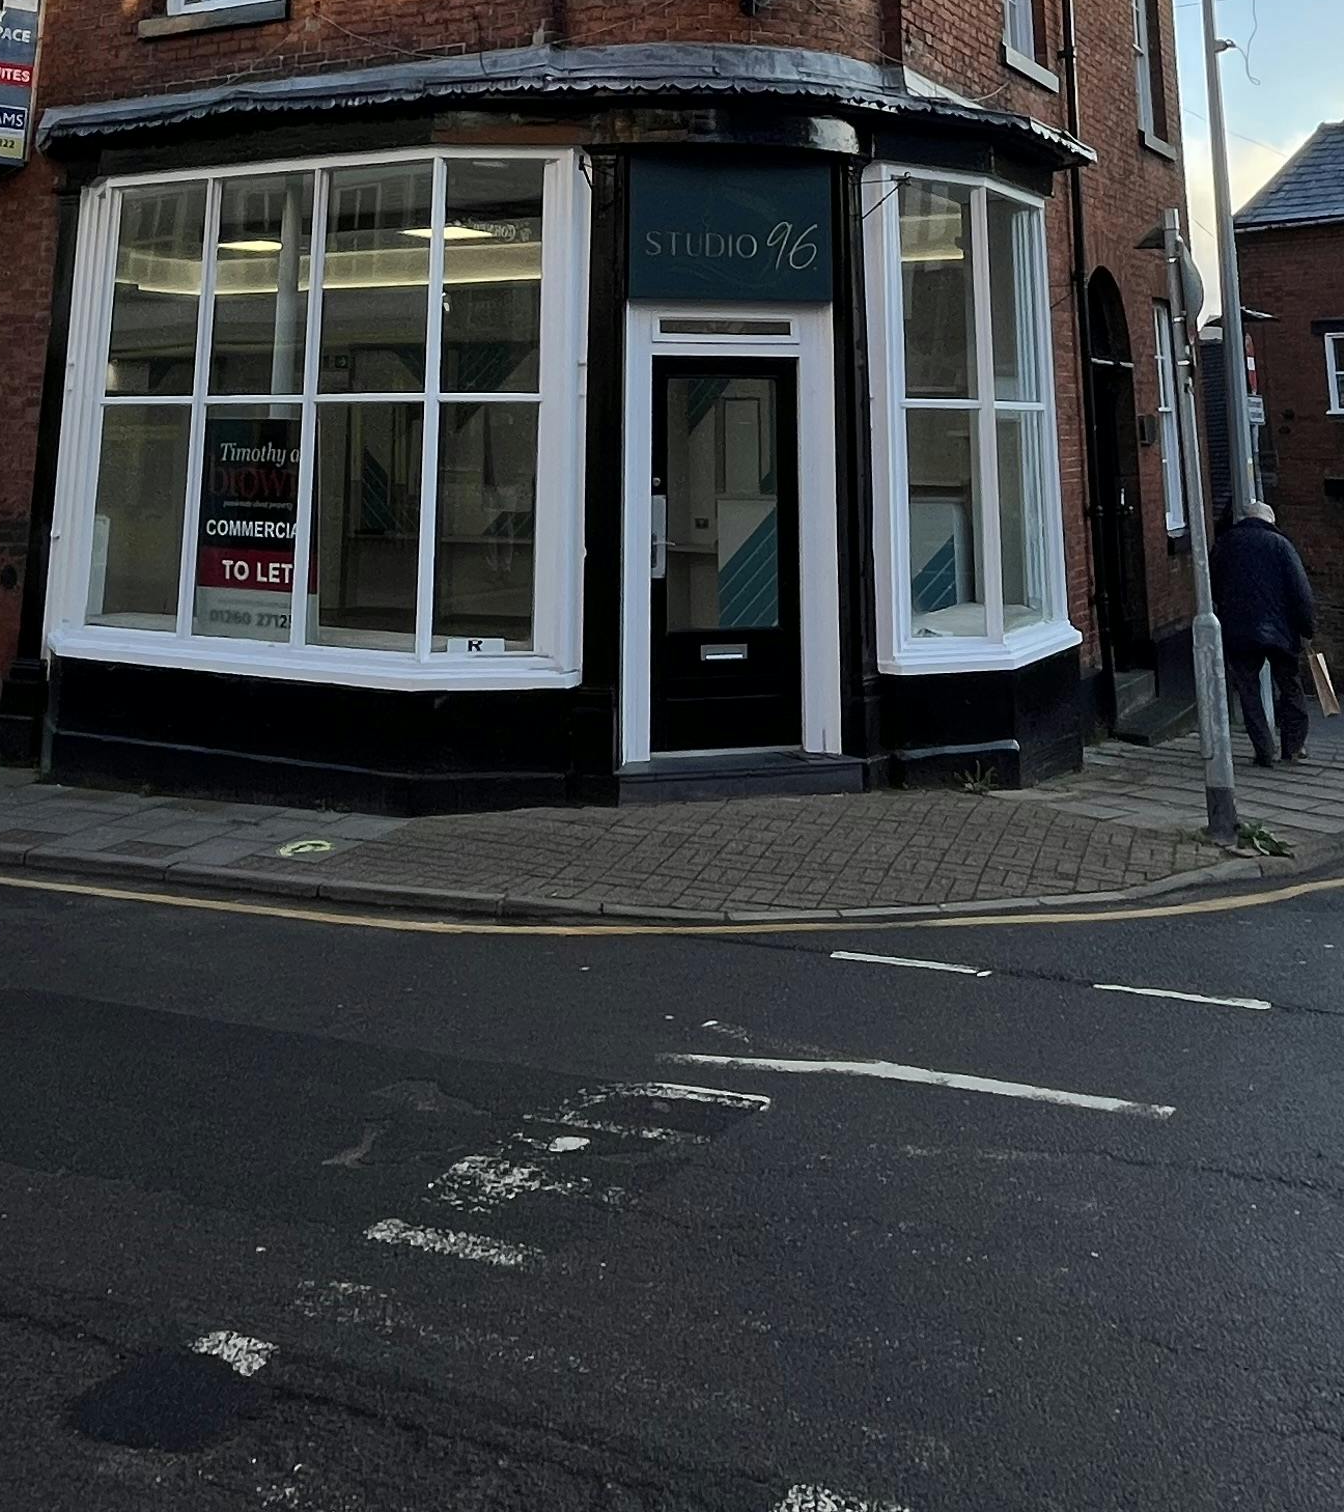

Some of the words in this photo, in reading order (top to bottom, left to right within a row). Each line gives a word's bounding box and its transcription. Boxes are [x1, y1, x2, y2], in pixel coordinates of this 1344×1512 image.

[645, 230, 758, 259] STUDIO
[219, 441, 287, 468] Timothy
[221, 559, 250, 581] TO
[256, 561, 294, 584] LET
